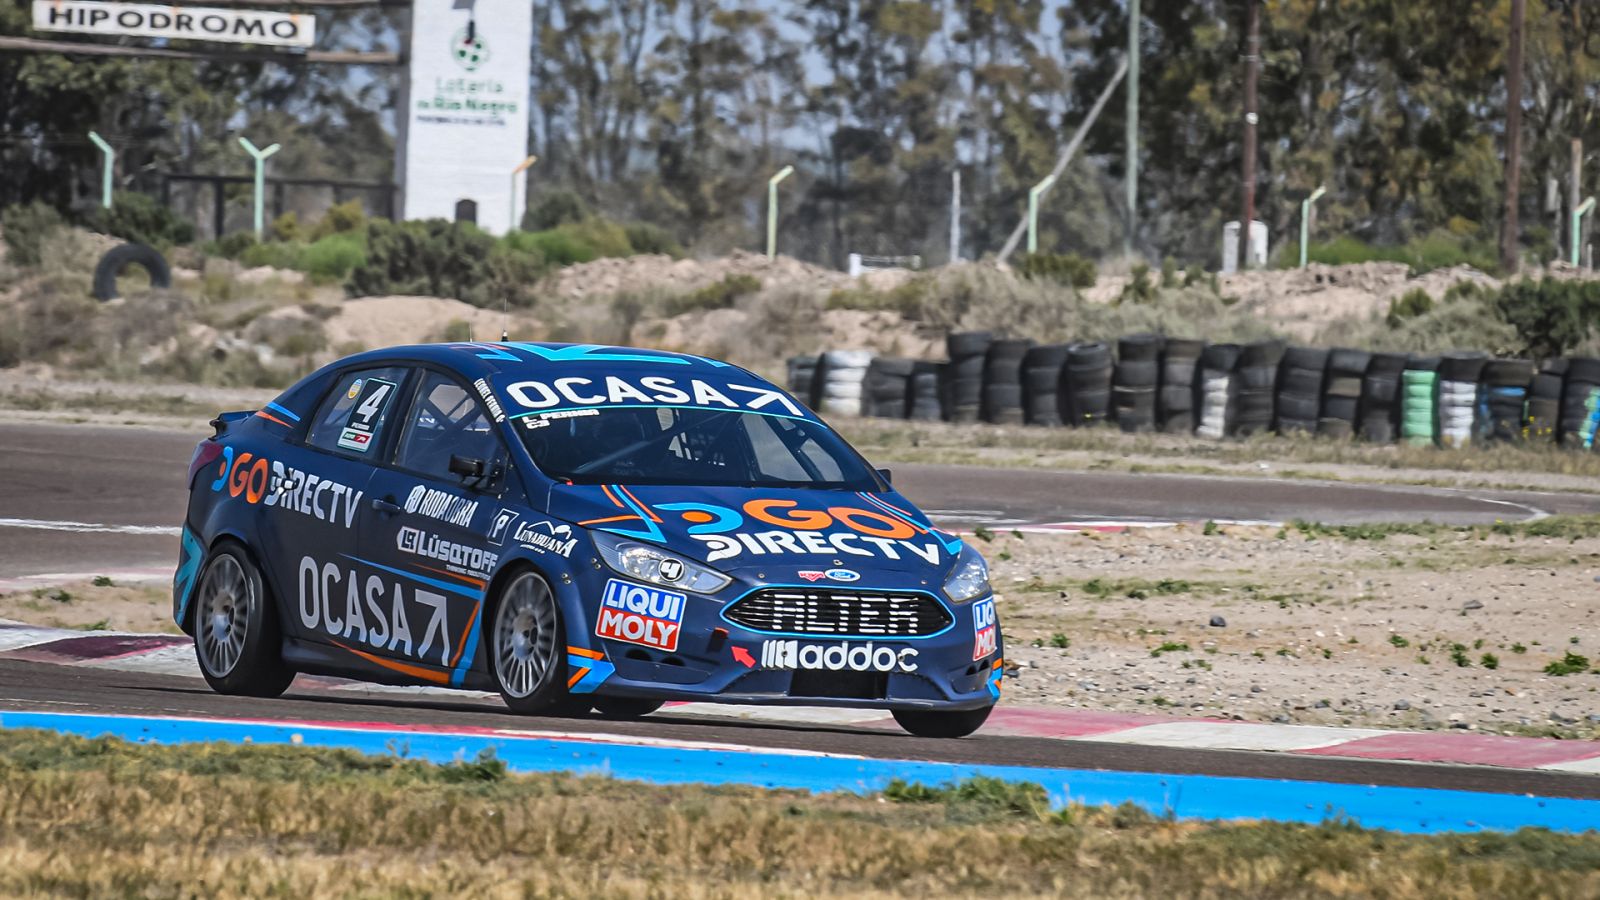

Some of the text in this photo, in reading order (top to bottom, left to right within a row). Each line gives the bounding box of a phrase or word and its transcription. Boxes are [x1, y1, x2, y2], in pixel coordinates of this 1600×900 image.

[49, 7, 298, 39] HIPODROMO
[356, 384, 391, 423] 4
[506, 376, 740, 408] OCASA
[264, 460, 363, 529] DIRECTV
[690, 530, 940, 566] DIRECTV
[659, 562, 681, 578] 4
[298, 555, 413, 657] OCASA
[606, 582, 681, 621] LIQUI
[600, 609, 678, 646] MOLY
[798, 640, 919, 672] addoc
